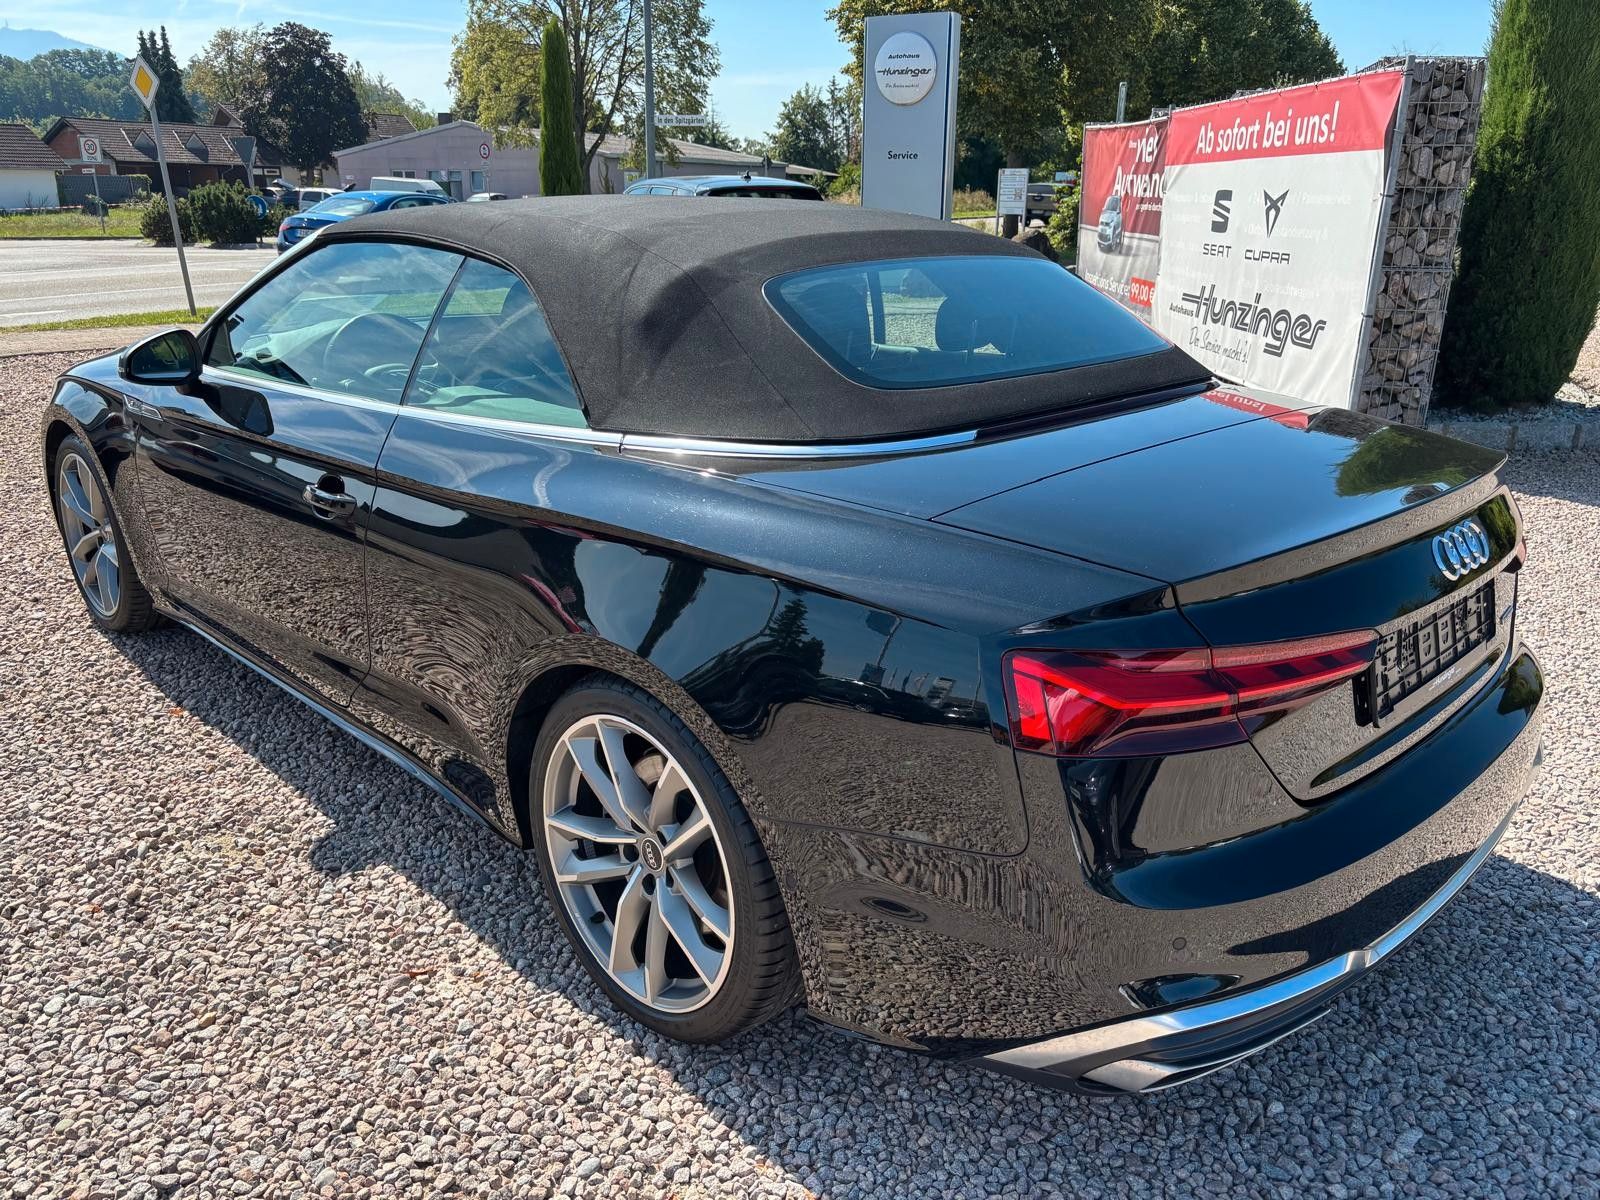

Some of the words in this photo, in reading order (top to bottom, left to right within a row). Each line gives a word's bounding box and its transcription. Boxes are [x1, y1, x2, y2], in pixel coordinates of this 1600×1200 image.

[877, 67, 931, 77] Hunzinger
[1196, 121, 1214, 155] Ab
[1216, 117, 1261, 153] sofort
[1262, 108, 1293, 148] bei
[1294, 99, 1340, 146] uns!
[887, 150, 918, 160] Service
[1202, 243, 1232, 259] SEAT
[1244, 248, 1291, 265] CUPRA
[1131, 282, 1149, 303] 99,00
[1168, 302, 1194, 317] Autohaus
[1181, 284, 1327, 358] Hunzinger
[1200, 329, 1221, 355] Service
